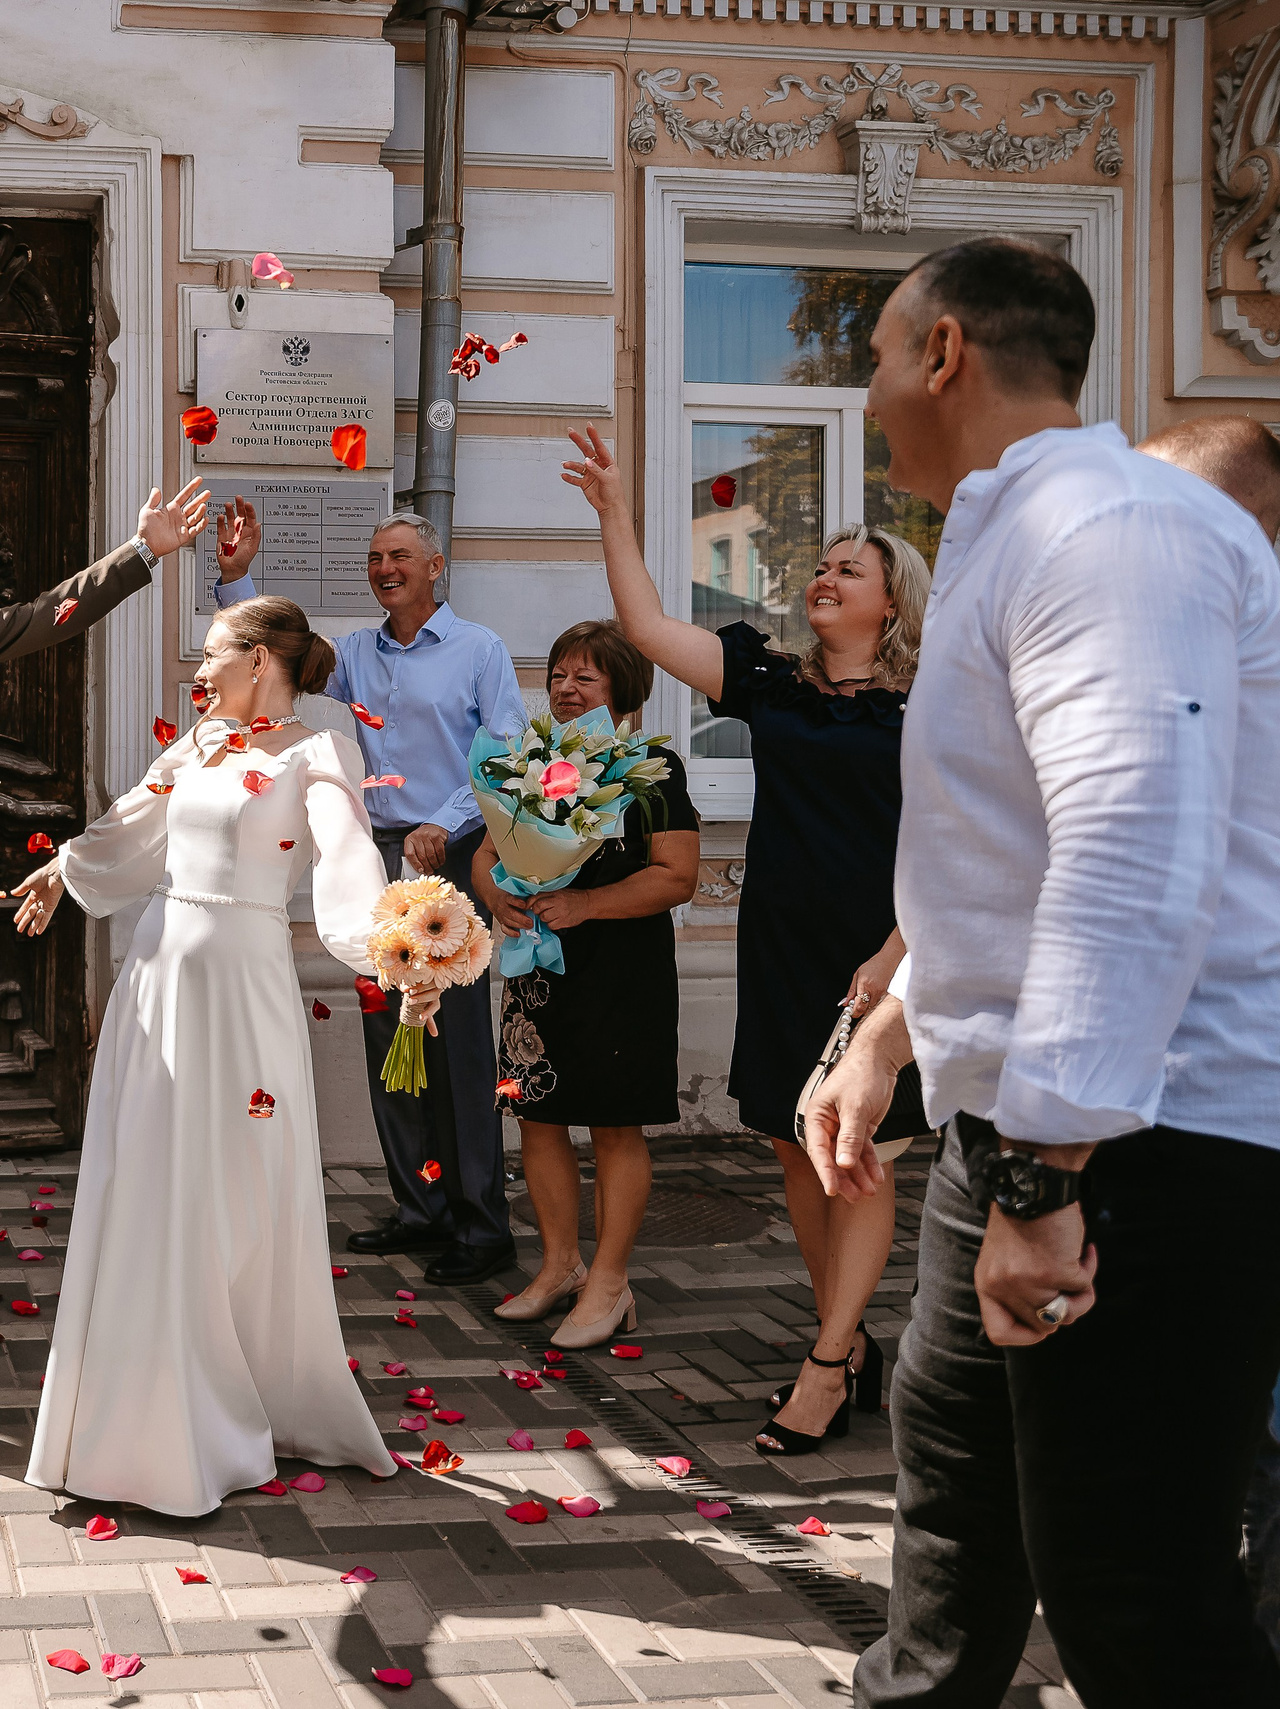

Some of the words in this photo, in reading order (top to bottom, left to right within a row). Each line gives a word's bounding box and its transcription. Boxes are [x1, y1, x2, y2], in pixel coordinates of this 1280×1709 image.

[225, 390, 268, 404] Сектор
[271, 394, 367, 405] государственной
[218, 407, 292, 418] регистрации
[296, 407, 338, 418] Отдела
[340, 408, 374, 419] ЗАГС
[249, 421, 337, 434] Администраци
[231, 436, 270, 447] города
[255, 484, 290, 493] РЕЖИМ
[292, 485, 330, 494] РАБОТЫ
